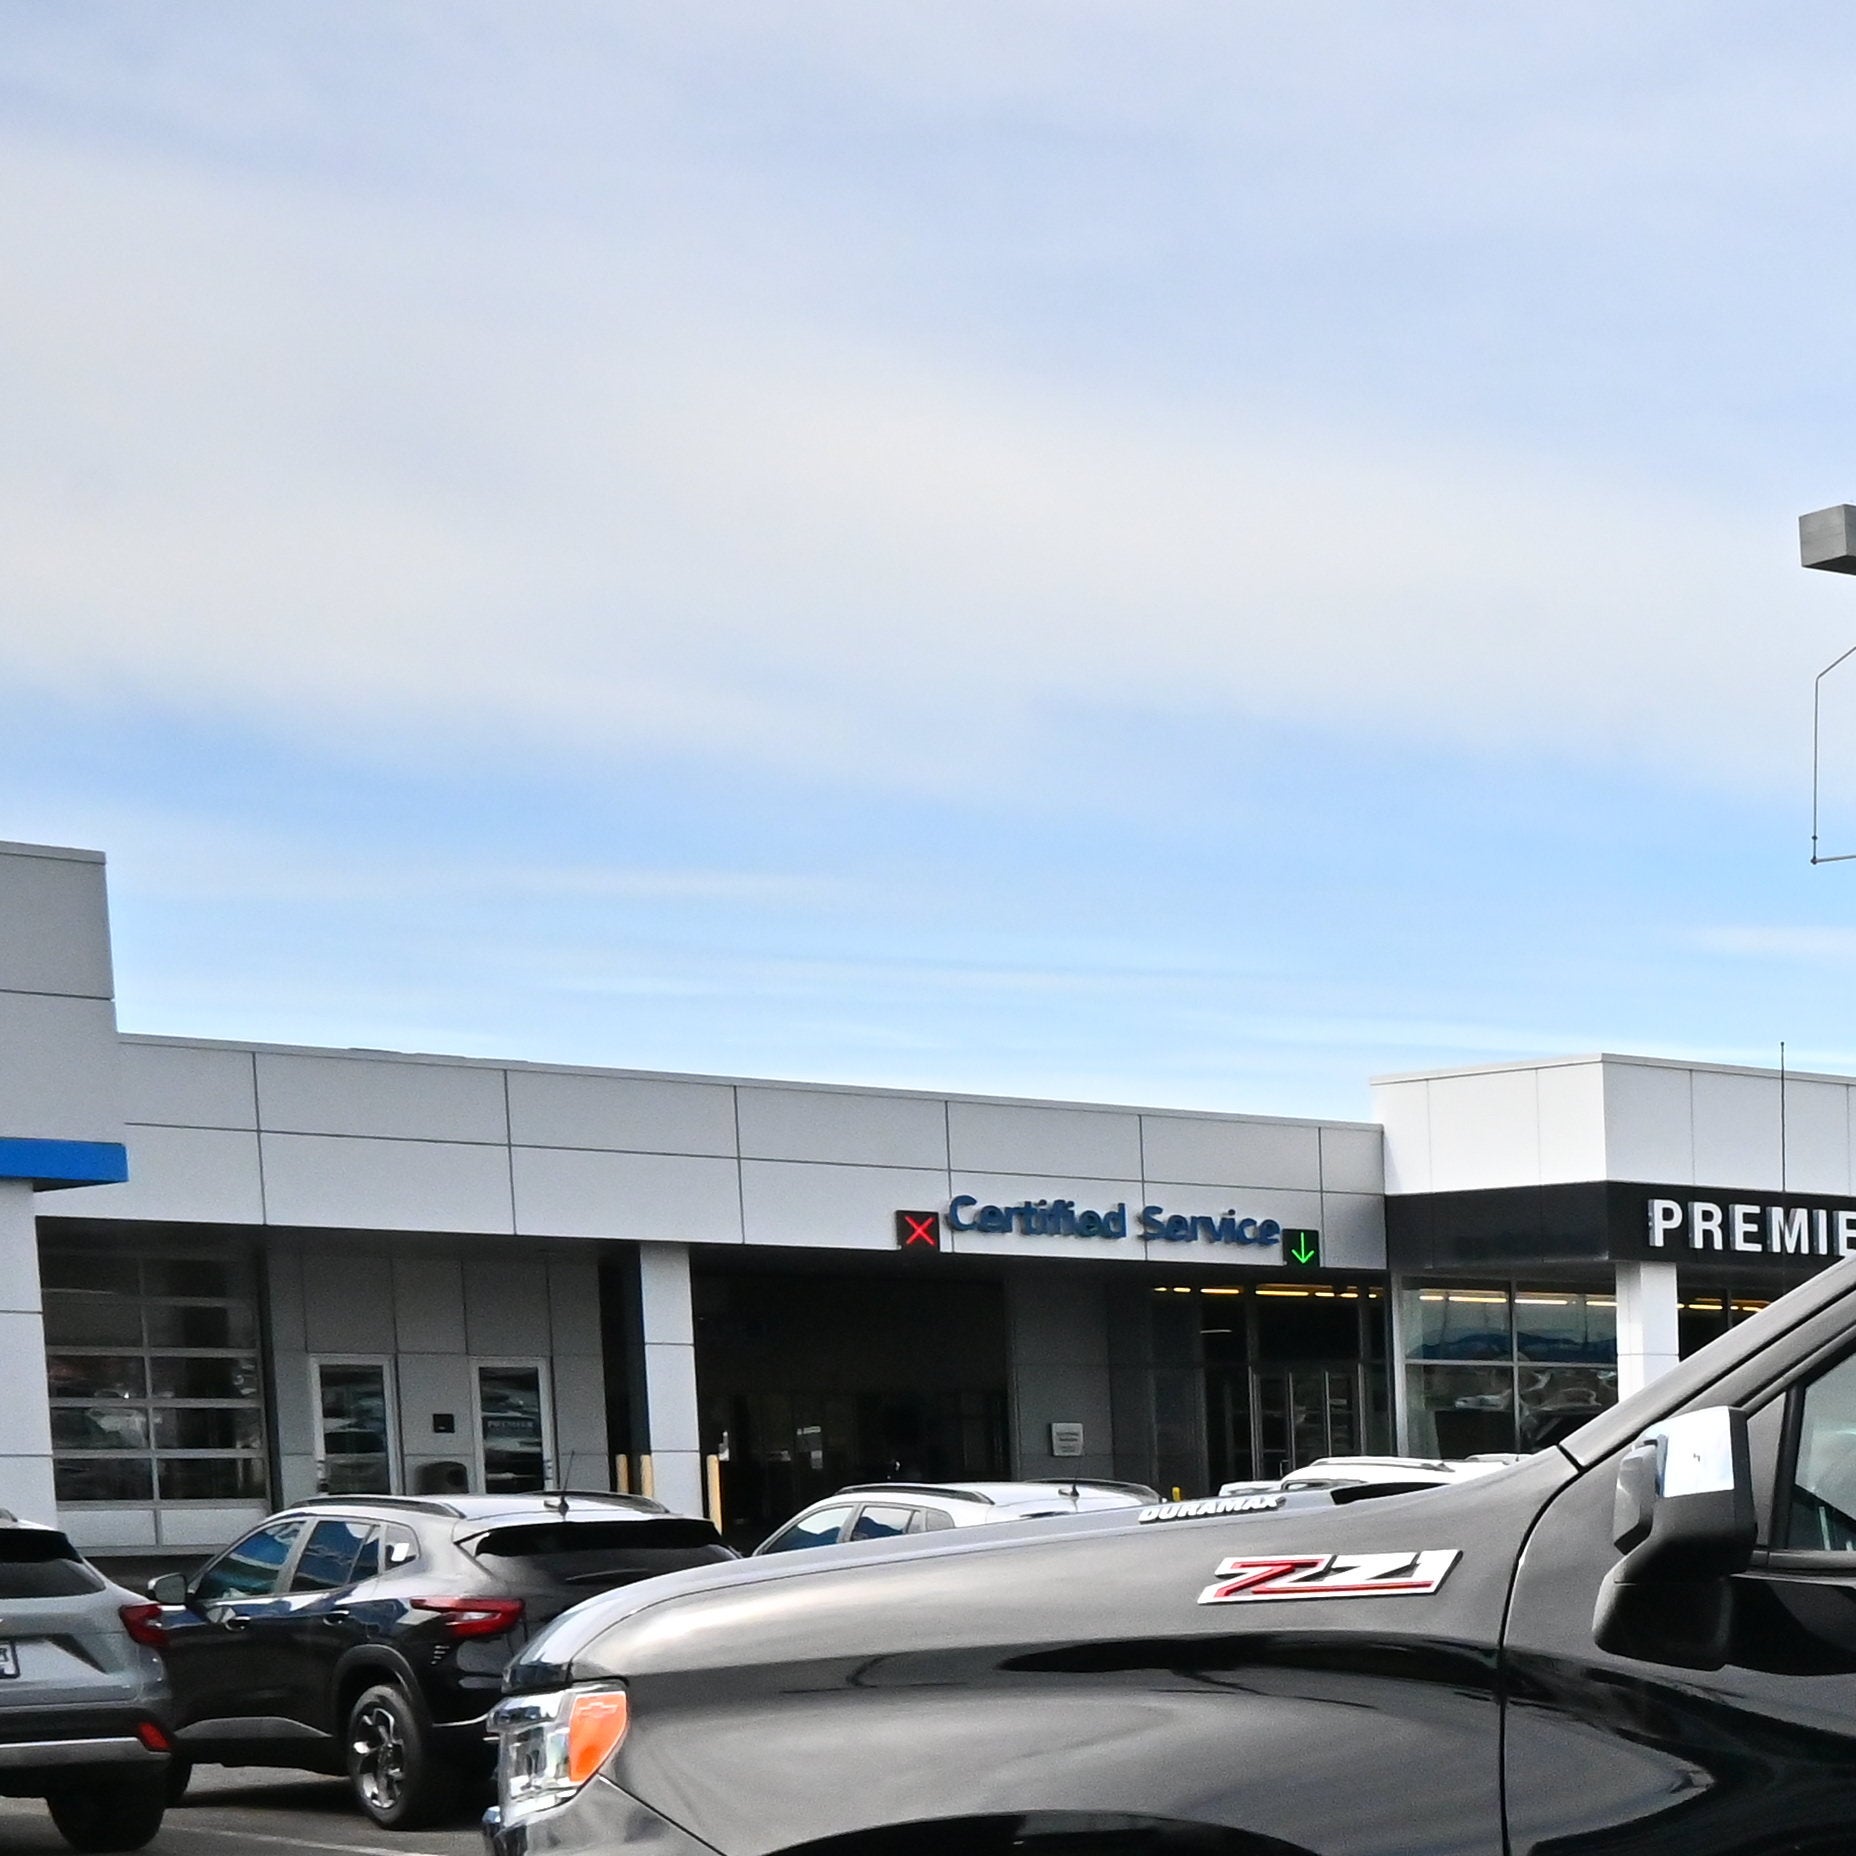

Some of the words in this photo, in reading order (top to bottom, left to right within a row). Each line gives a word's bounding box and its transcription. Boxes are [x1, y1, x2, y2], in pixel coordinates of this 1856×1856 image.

[949, 1194, 1127, 1238] Certified
[1140, 1205, 1281, 1247] Service
[1138, 1494, 1284, 1524] DURAMAX
[1197, 1549, 1462, 1605] Z71
